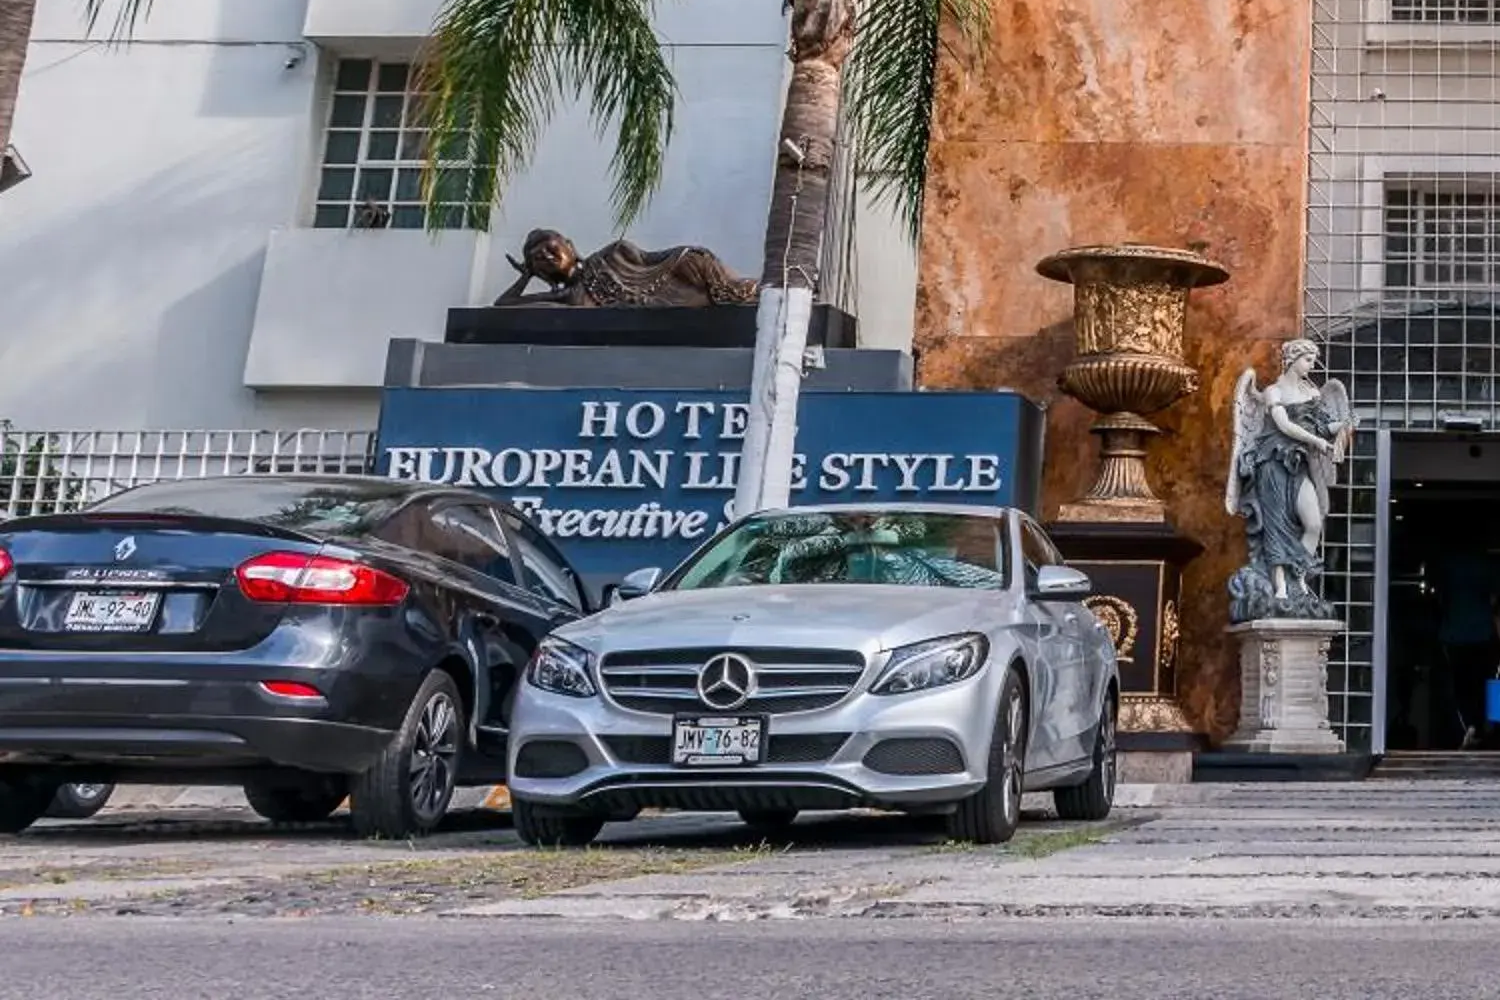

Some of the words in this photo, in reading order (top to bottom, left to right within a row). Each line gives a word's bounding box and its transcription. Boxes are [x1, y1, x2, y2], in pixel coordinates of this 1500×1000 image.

[579, 401, 796, 439] HOTE
[385, 447, 675, 489] EUROPEAN
[681, 452, 807, 489] LIE
[819, 453, 1002, 491] STYLE
